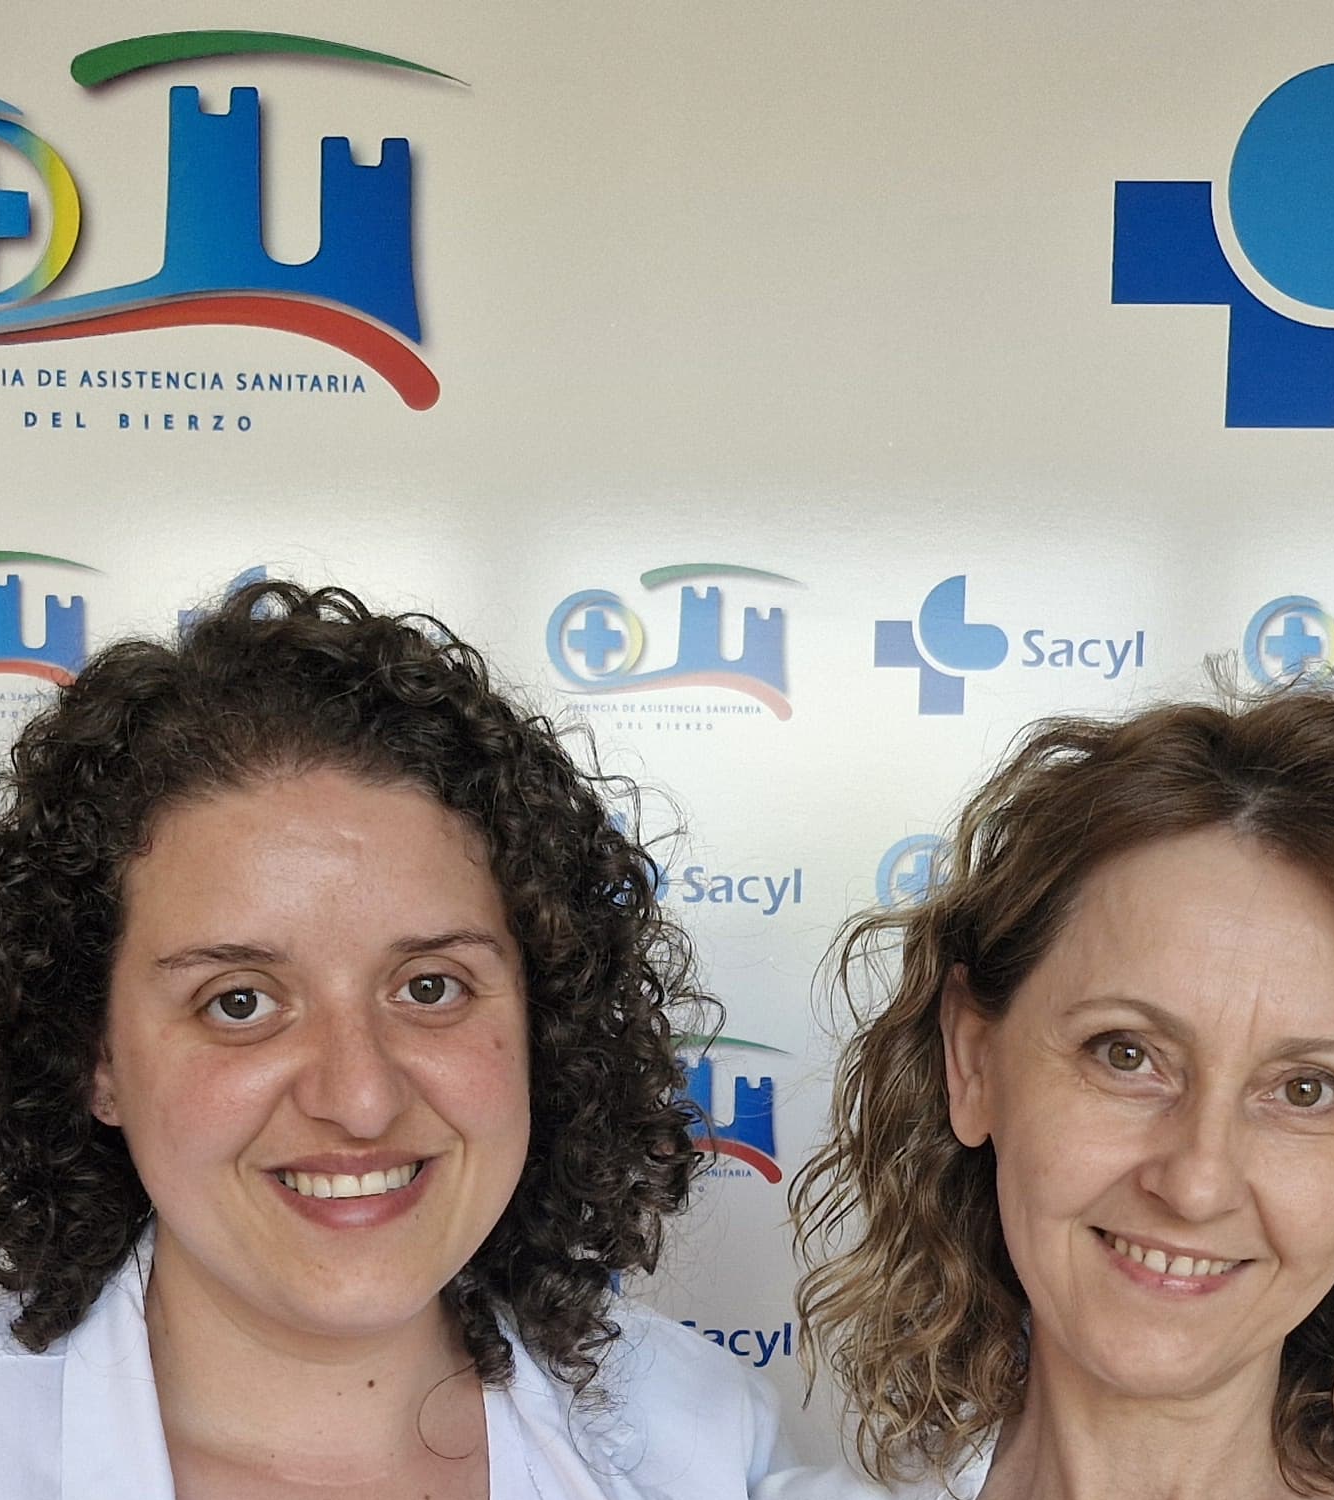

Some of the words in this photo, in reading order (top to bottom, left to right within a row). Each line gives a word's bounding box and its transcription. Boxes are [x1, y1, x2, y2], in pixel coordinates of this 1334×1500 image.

[37, 368, 68, 389] DE
[79, 370, 225, 391] ASISTENCIA
[236, 373, 367, 394] SANITARIA
[25, 410, 87, 429] DEL
[119, 413, 253, 432] BIERZO
[1021, 629, 1145, 680] Sacyl
[682, 865, 803, 916] Sacyl
